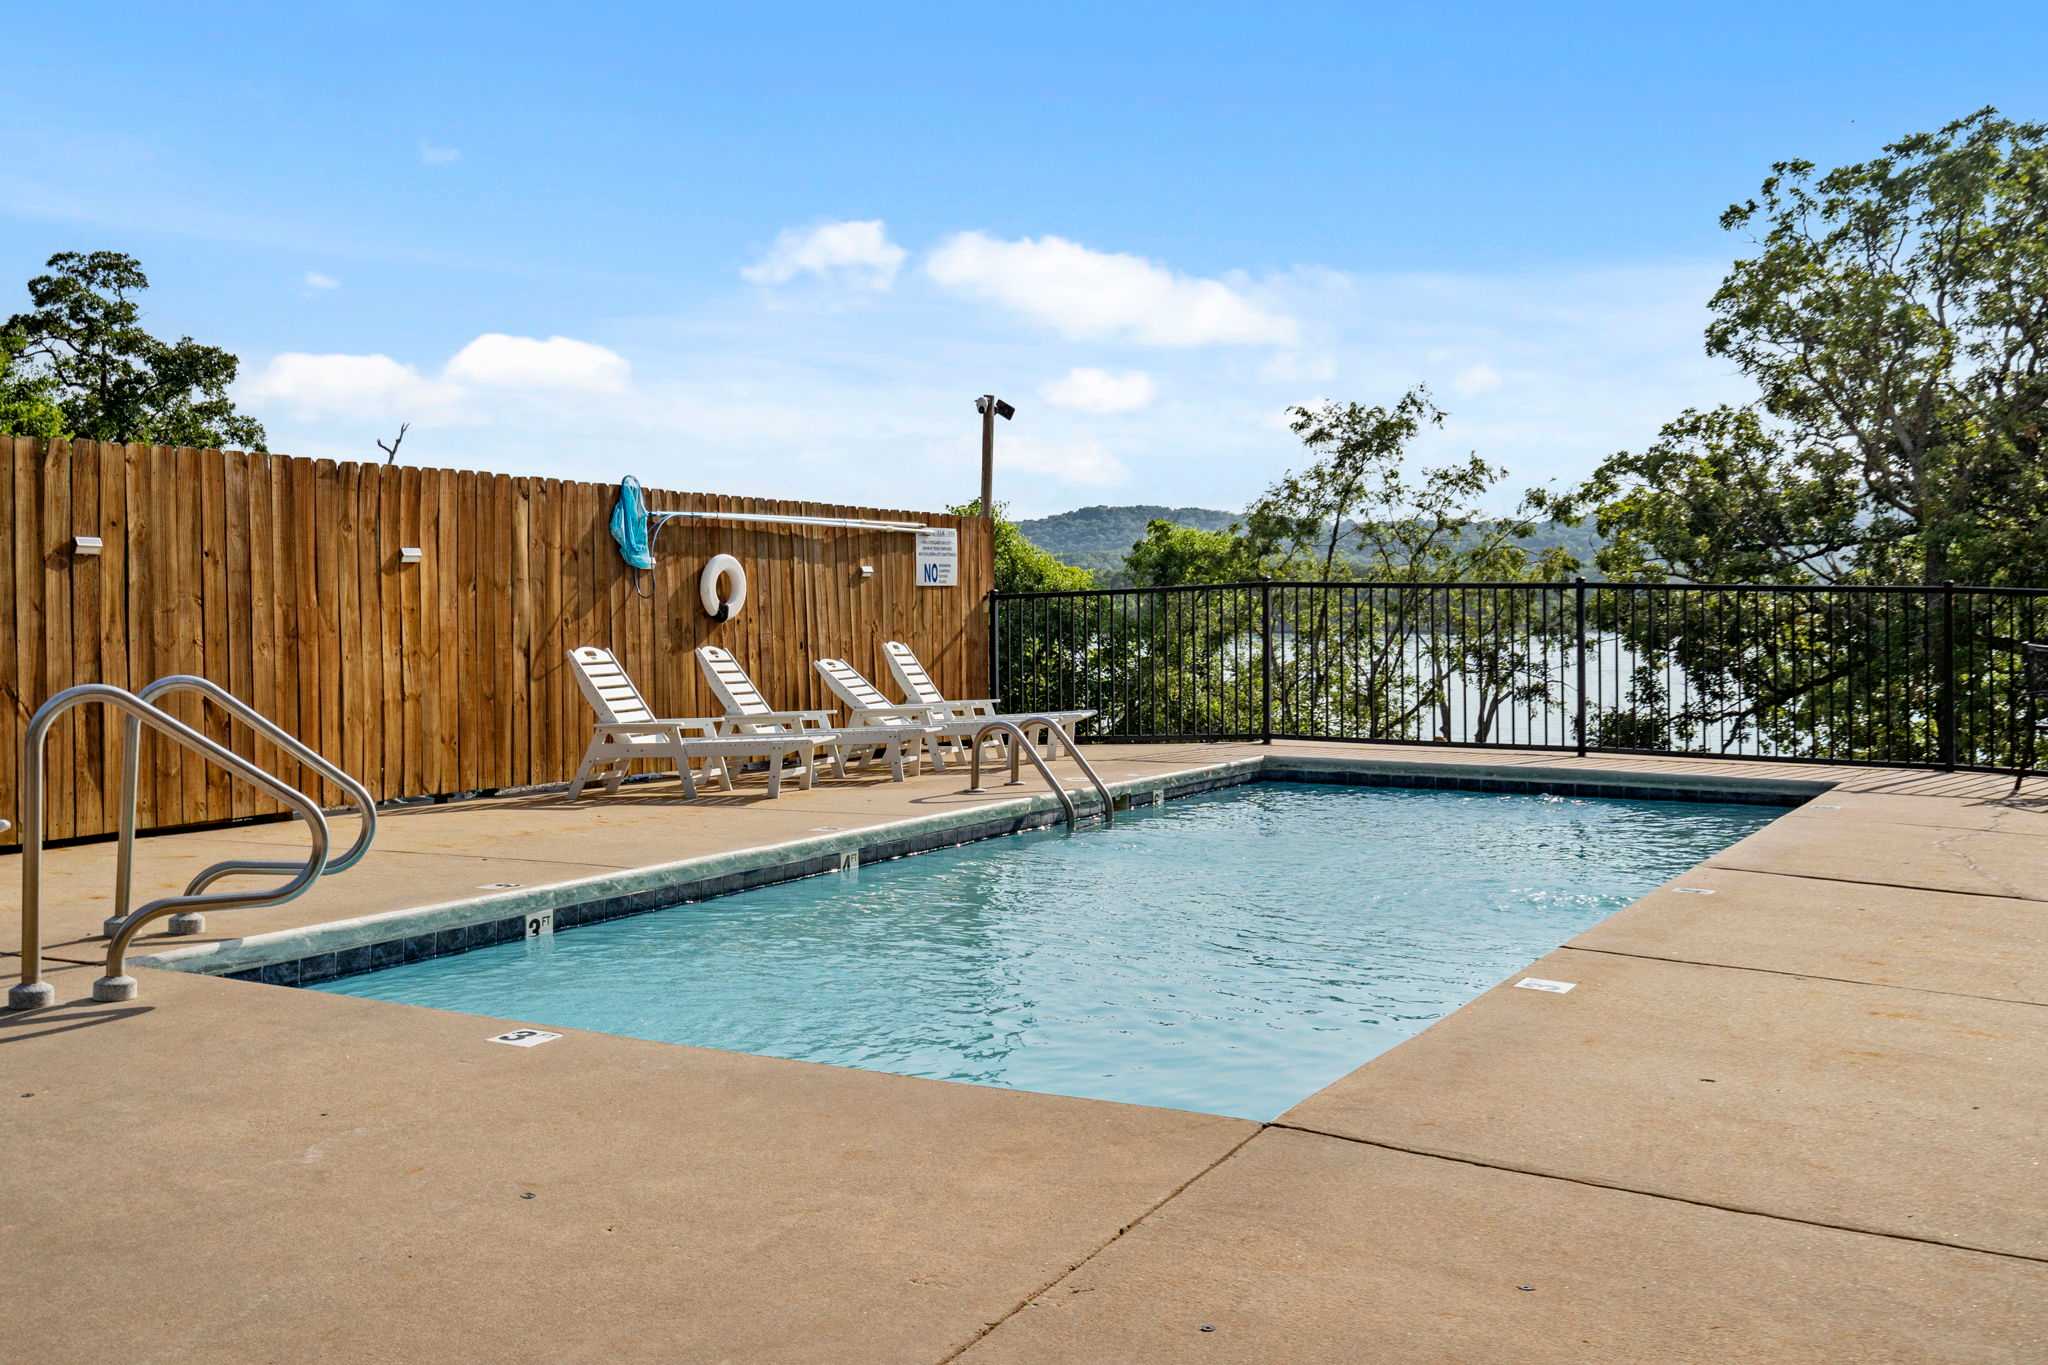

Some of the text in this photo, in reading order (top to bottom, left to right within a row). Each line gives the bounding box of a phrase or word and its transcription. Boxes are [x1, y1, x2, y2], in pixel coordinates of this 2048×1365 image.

[924, 563, 938, 583] NO
[528, 915, 551, 937] 3 FT
[499, 1031, 537, 1041] 3
